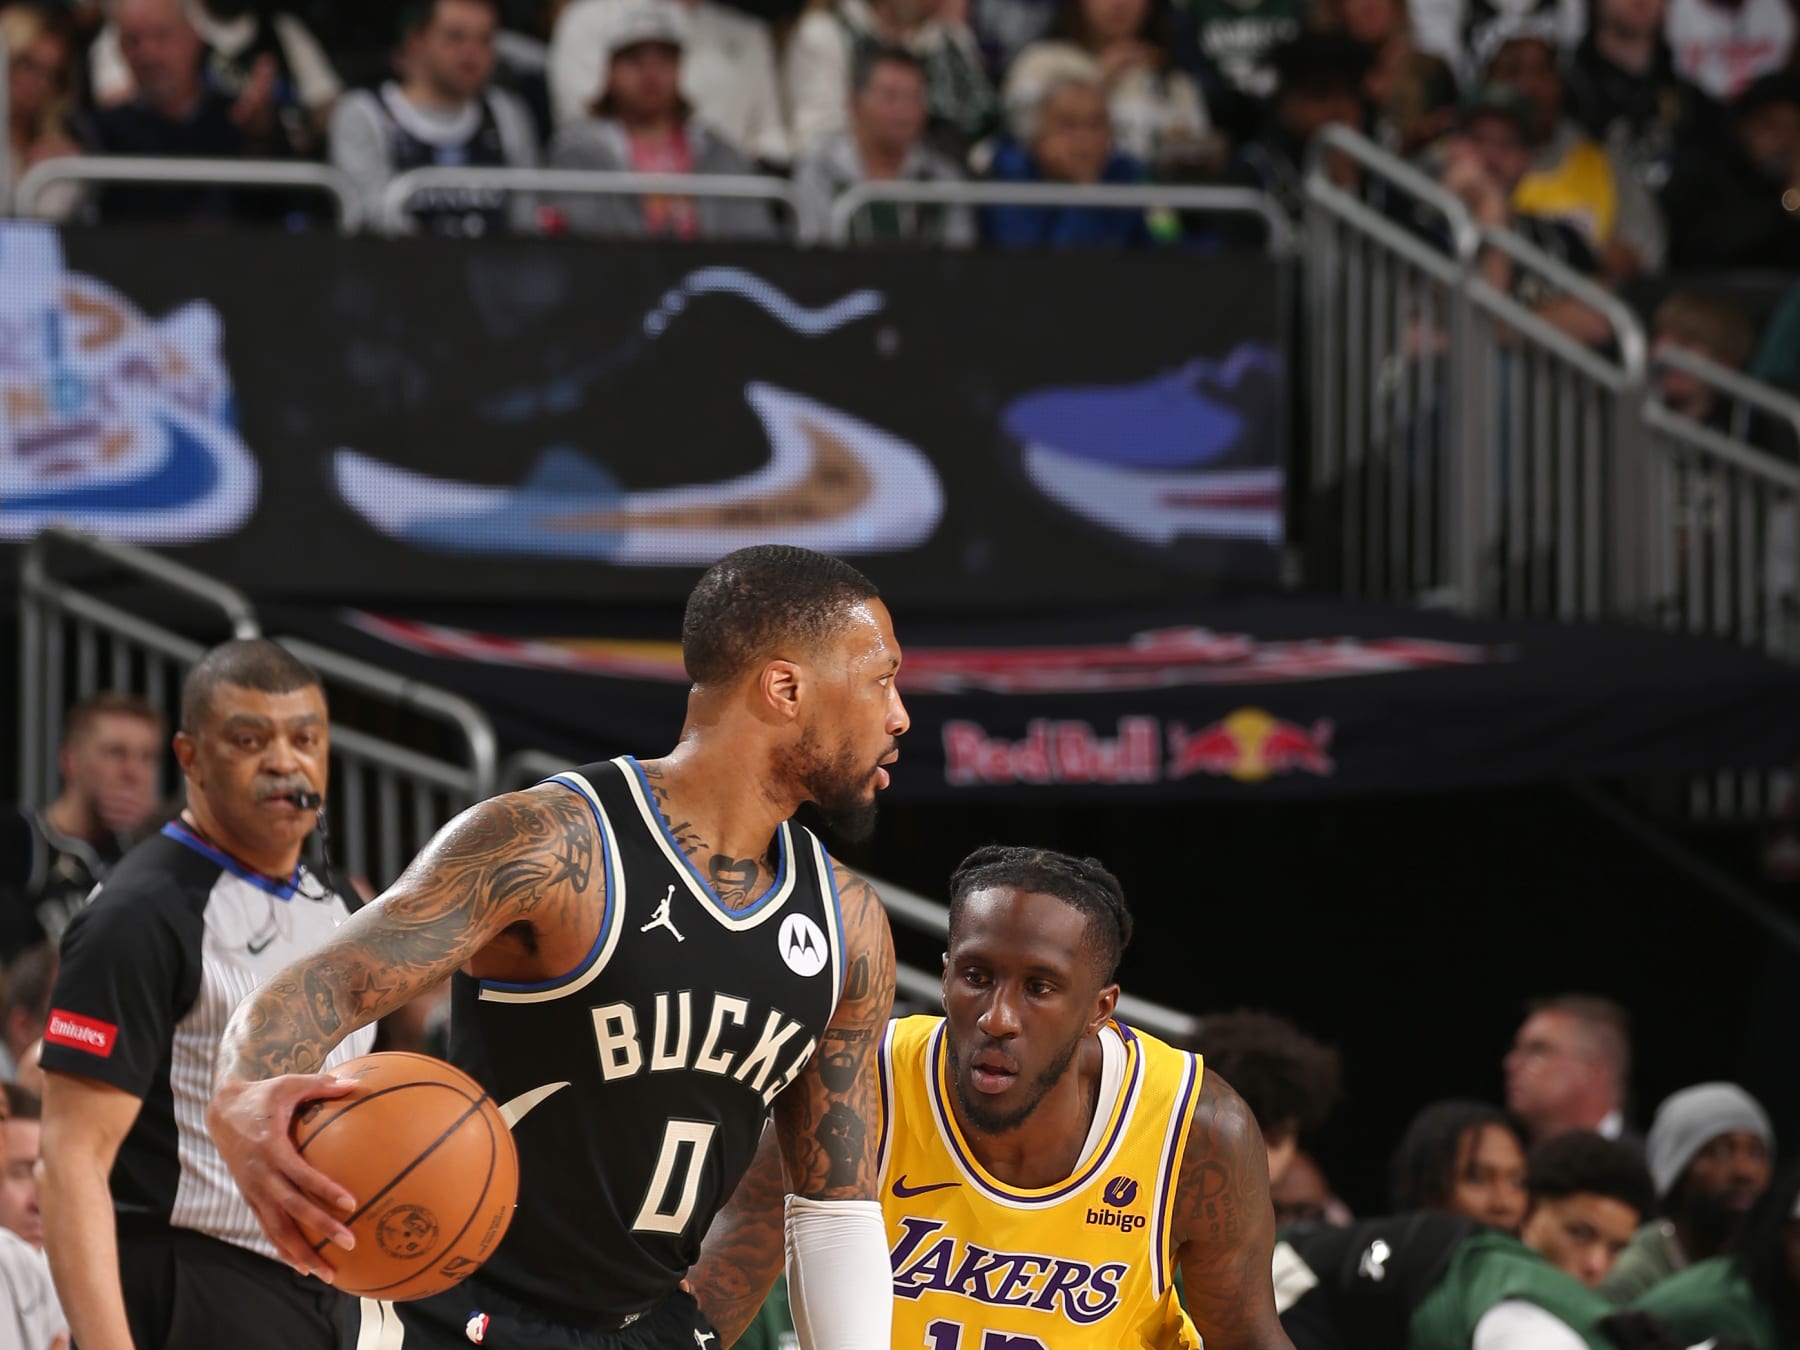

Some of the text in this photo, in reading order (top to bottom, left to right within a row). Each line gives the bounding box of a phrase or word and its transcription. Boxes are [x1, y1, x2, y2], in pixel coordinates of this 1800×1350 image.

[944, 716, 1158, 785] Red Bull
[49, 1016, 106, 1047] Emirates
[630, 1117, 718, 1237] 0
[1086, 1208, 1146, 1232] bibigo
[890, 1216, 1130, 1325] LAKERS
